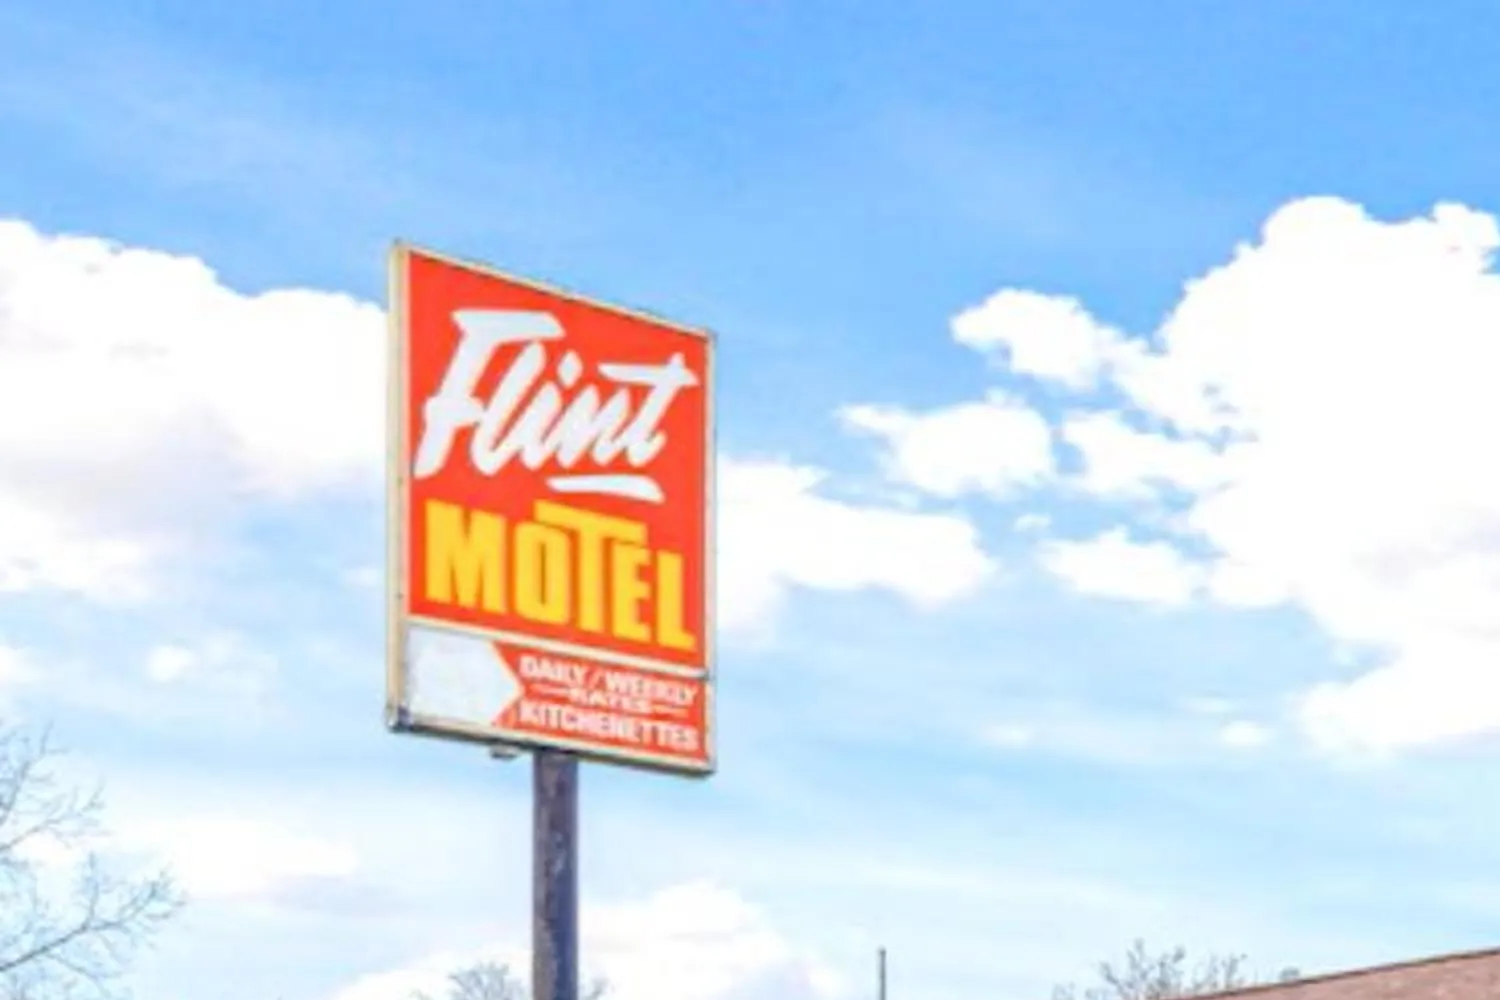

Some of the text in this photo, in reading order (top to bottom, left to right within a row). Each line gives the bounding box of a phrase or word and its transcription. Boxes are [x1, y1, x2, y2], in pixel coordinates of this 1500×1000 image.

[411, 309, 698, 479] Flint
[425, 498, 696, 649] MOTEL
[519, 655, 586, 689] DAILY
[605, 671, 698, 706] WEEKLY
[519, 700, 699, 750] KITCHENETTES
